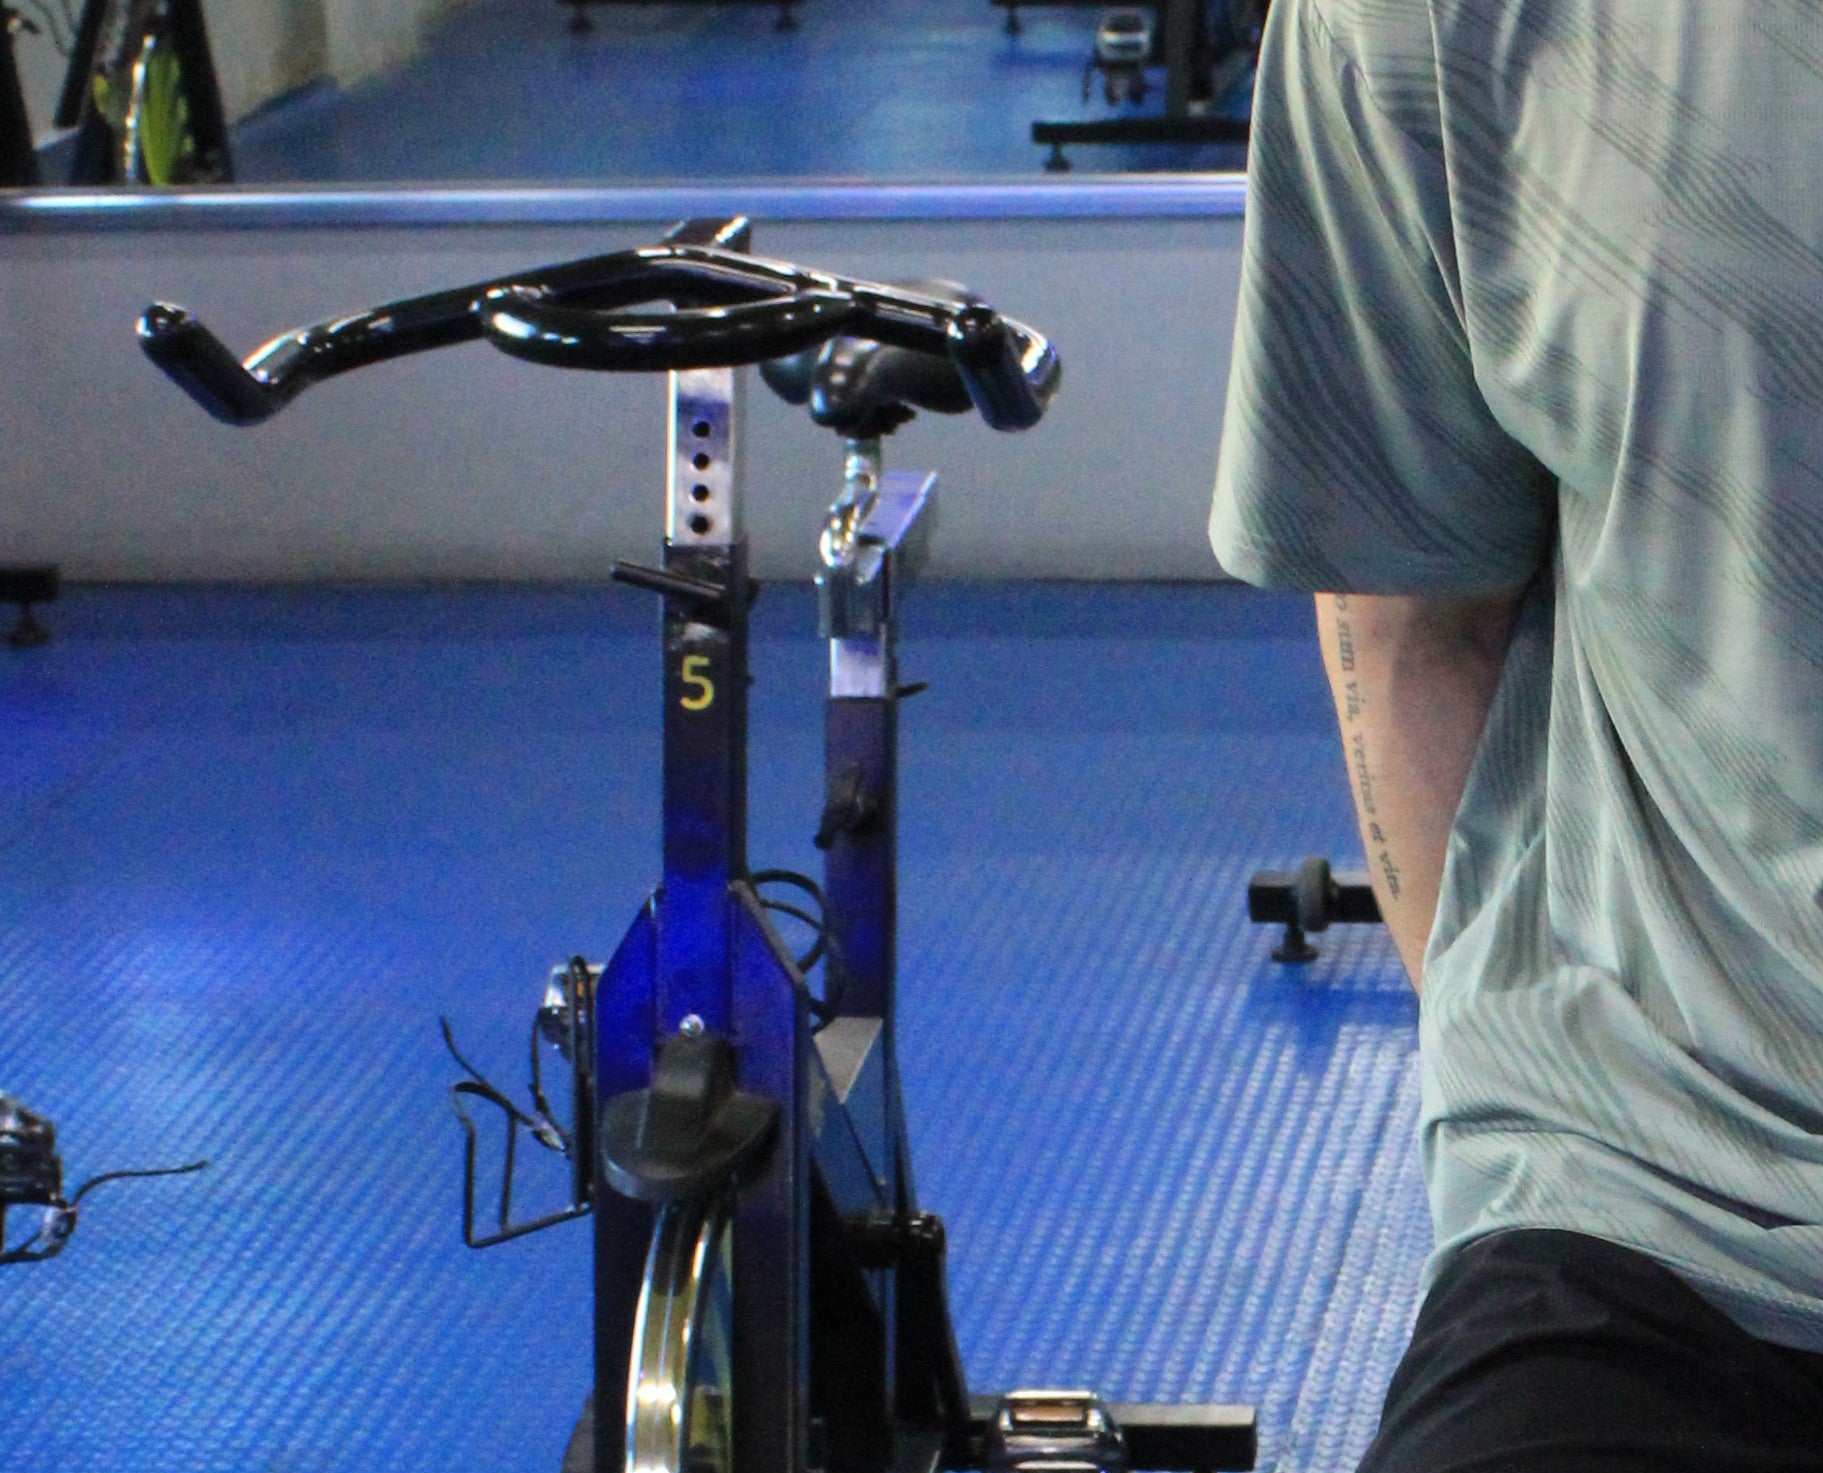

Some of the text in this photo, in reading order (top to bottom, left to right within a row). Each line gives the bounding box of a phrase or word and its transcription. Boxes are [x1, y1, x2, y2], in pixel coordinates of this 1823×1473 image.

[680, 657, 713, 709] 5
[1337, 617, 1354, 671] sum
[1369, 822, 1386, 843] et
